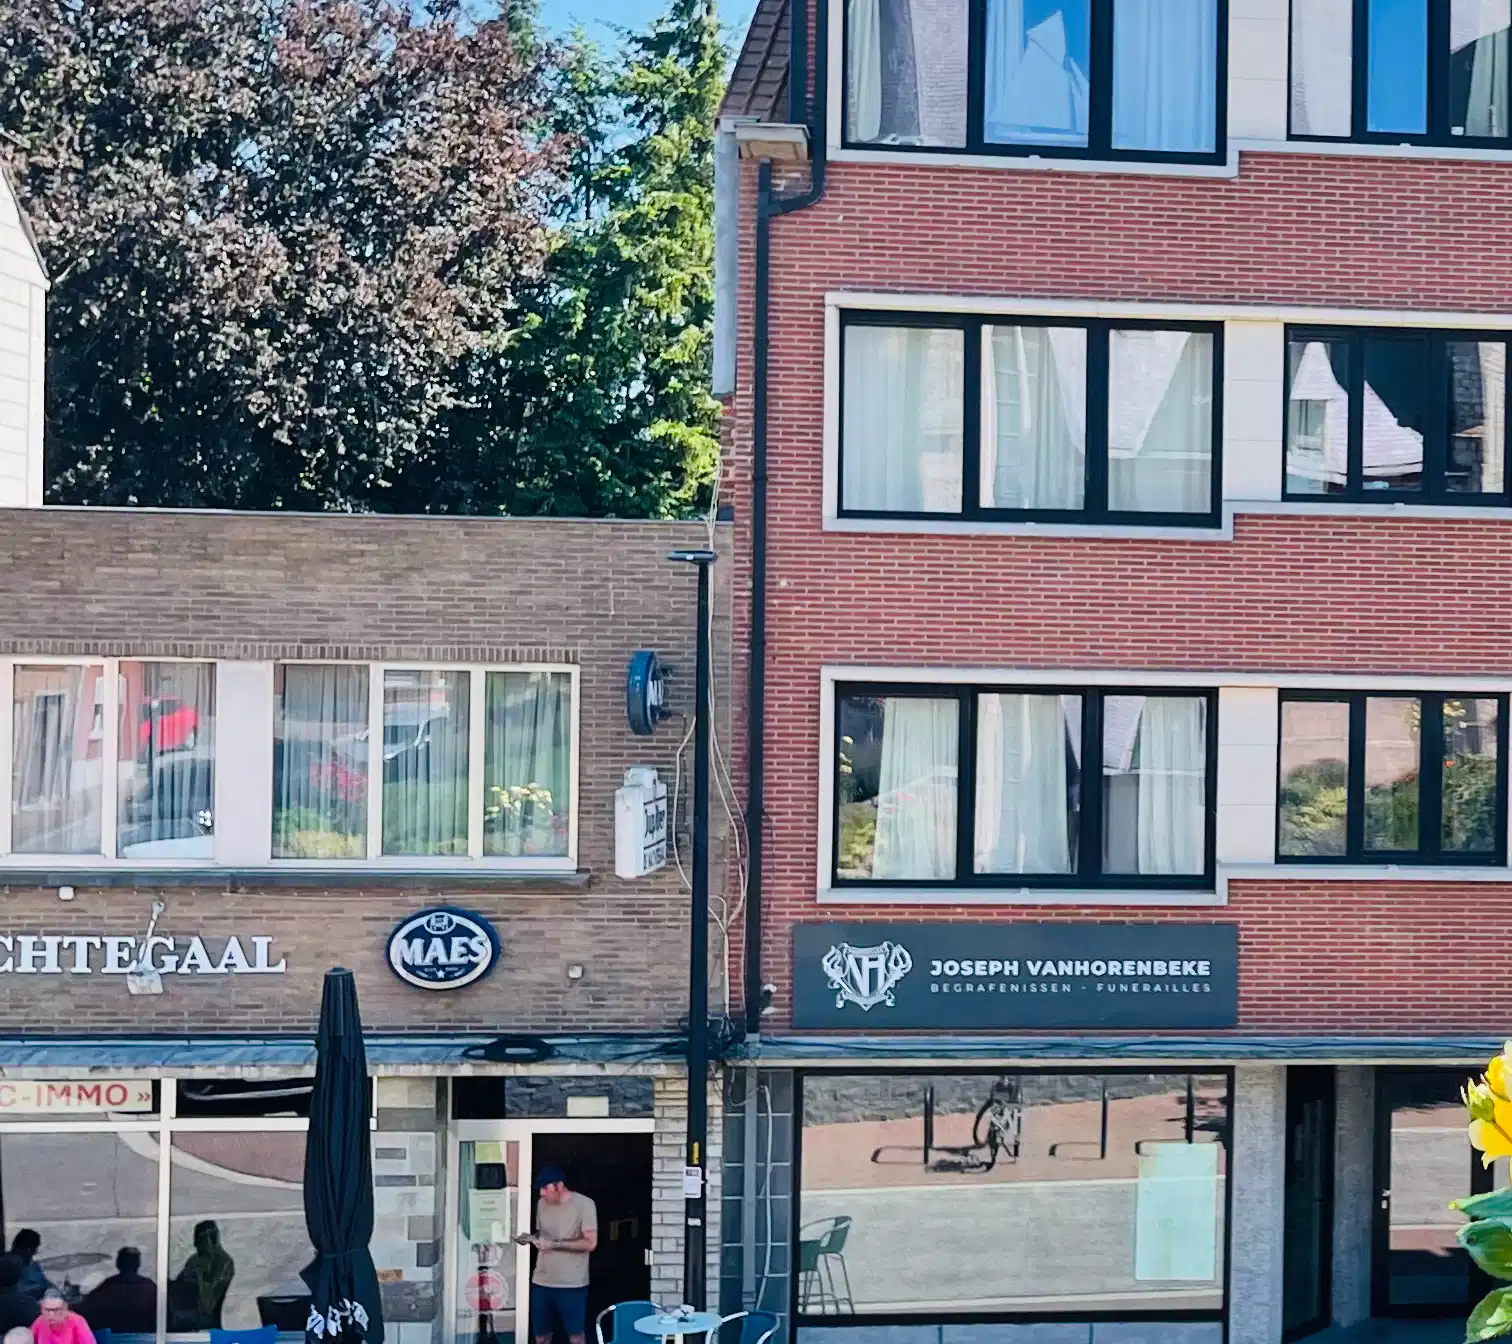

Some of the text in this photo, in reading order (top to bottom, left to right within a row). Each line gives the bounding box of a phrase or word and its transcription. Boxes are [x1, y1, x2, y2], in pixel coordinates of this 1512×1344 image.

[399, 936, 488, 966] MAES
[930, 960, 1211, 976] JOSEPH VANHORENBEKE
[930, 983, 1072, 993] BEGRAFENISSEN
[1096, 983, 1211, 993] FUNERAILLES
